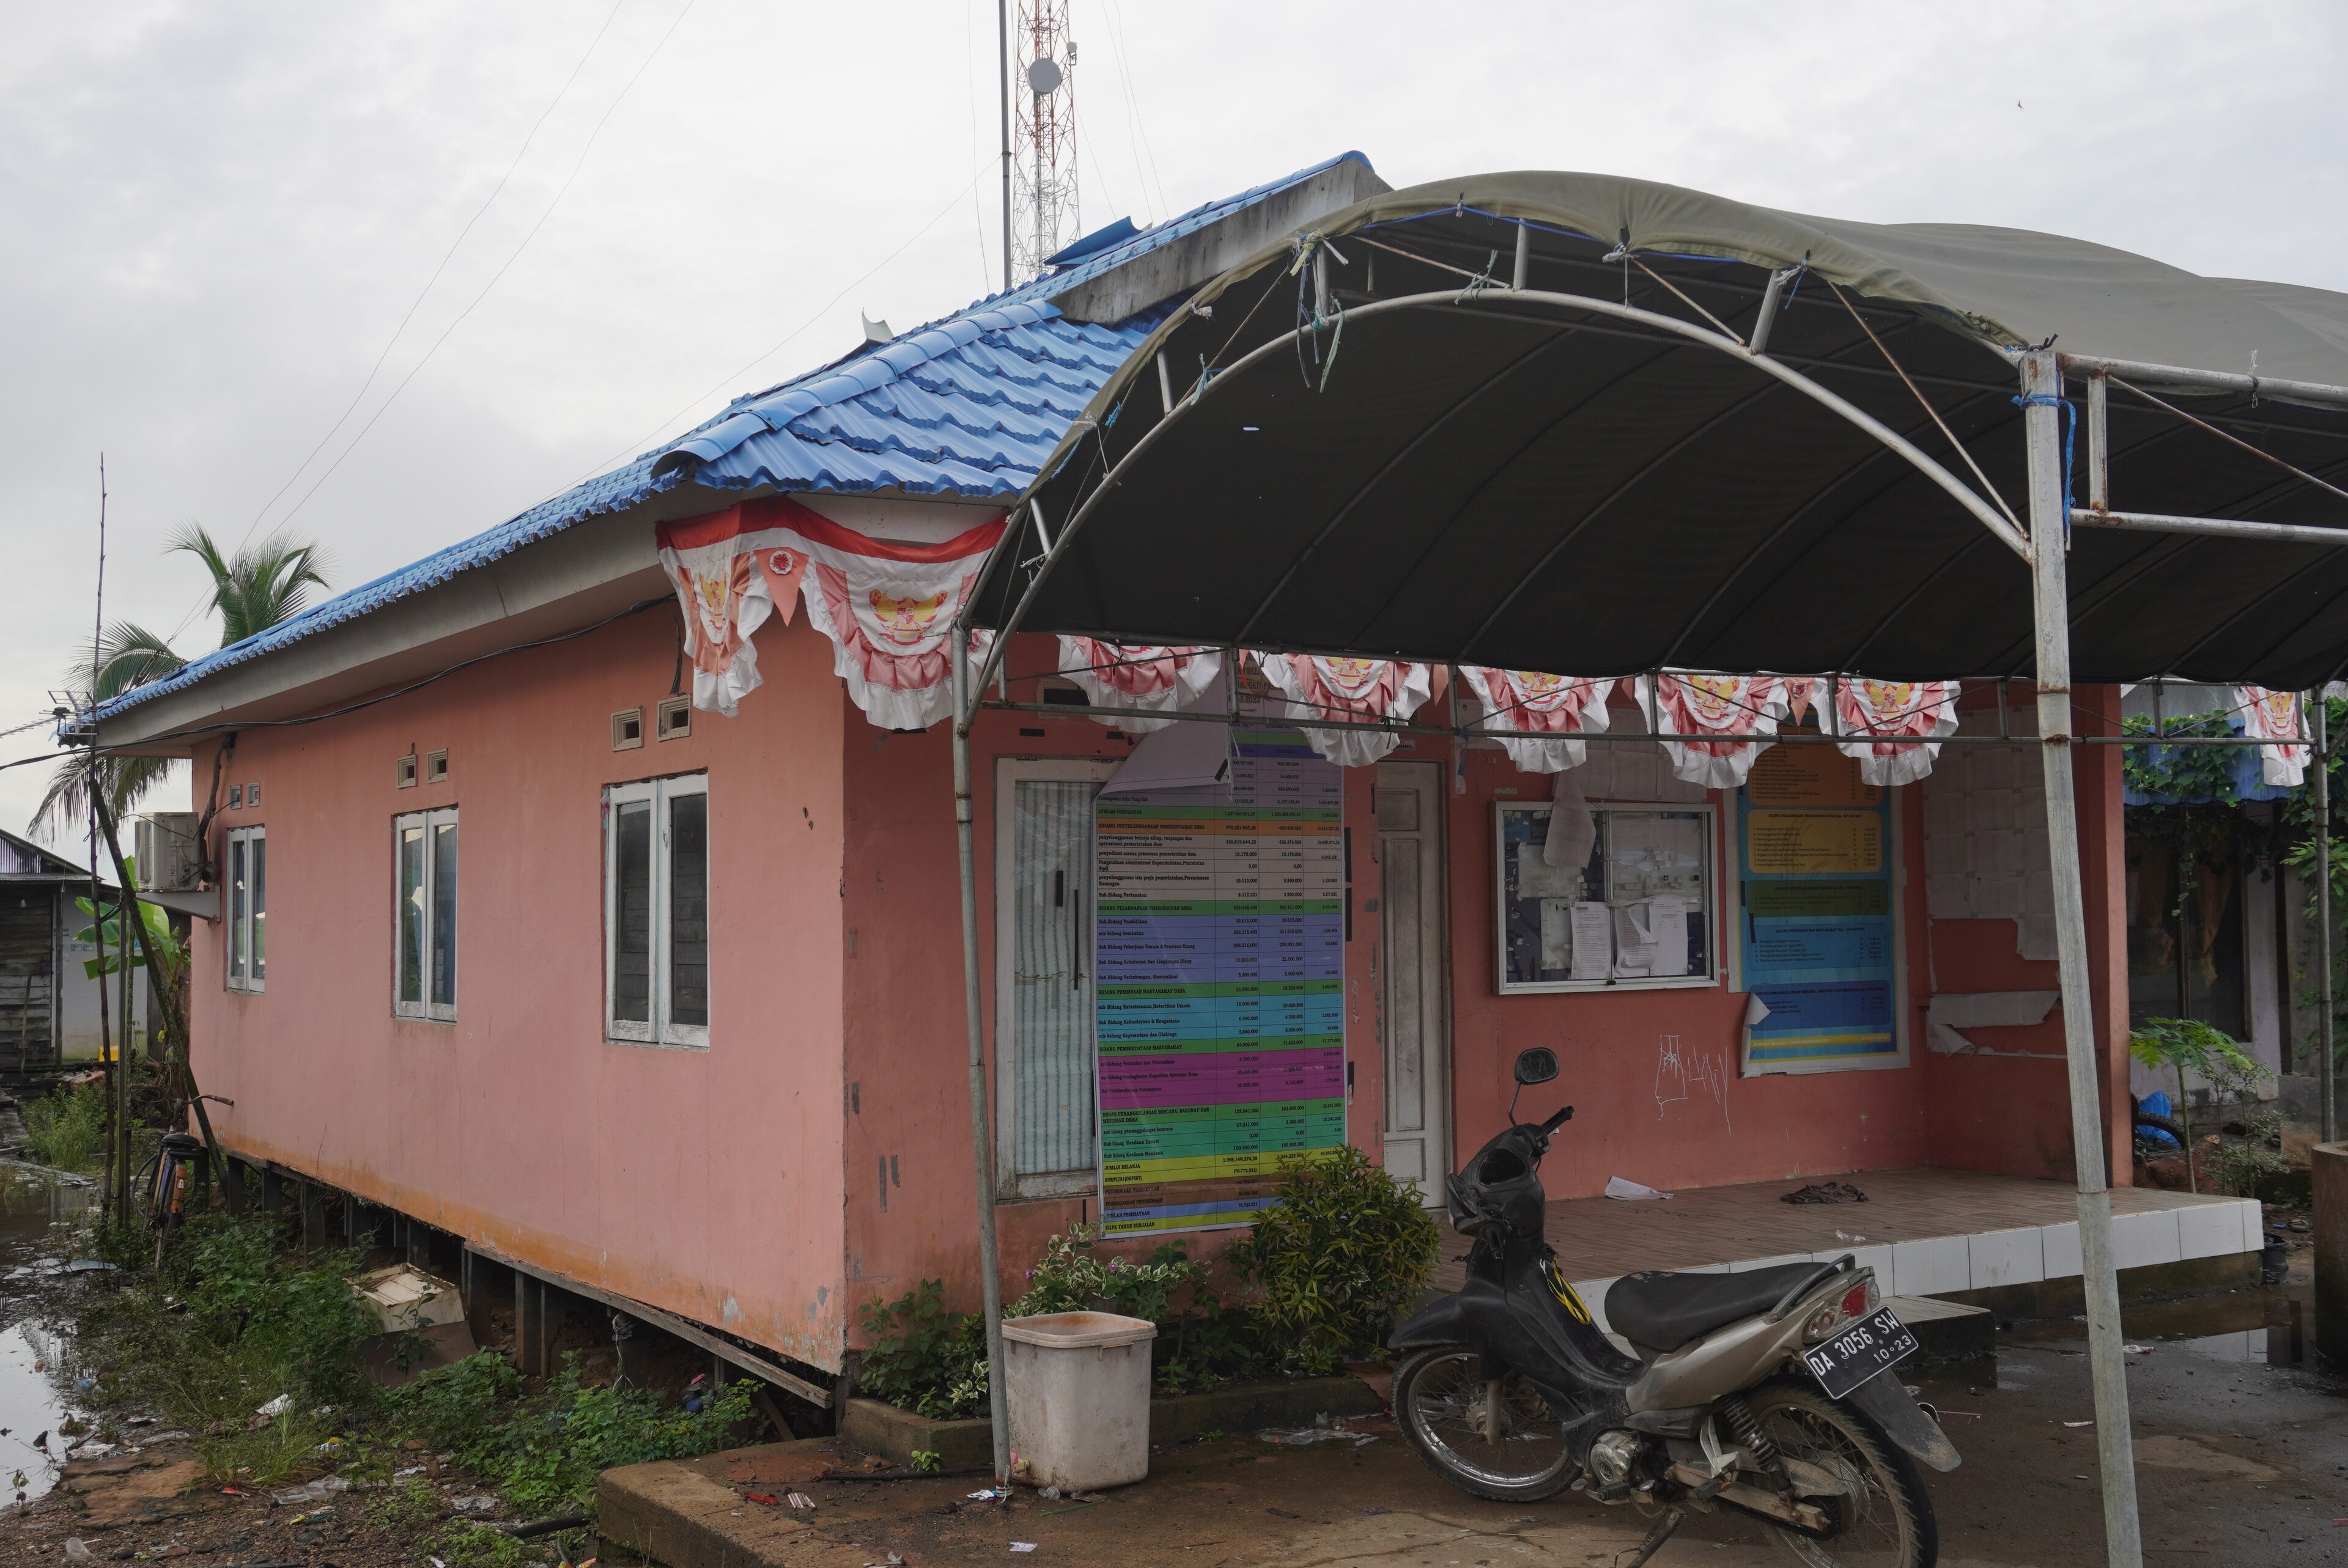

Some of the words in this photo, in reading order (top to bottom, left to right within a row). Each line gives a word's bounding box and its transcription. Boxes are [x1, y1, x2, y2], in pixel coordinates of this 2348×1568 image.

[1810, 1352, 1836, 1377] DA
[1834, 1327, 1874, 1360] 3056
[1874, 1310, 1900, 1335] SW
